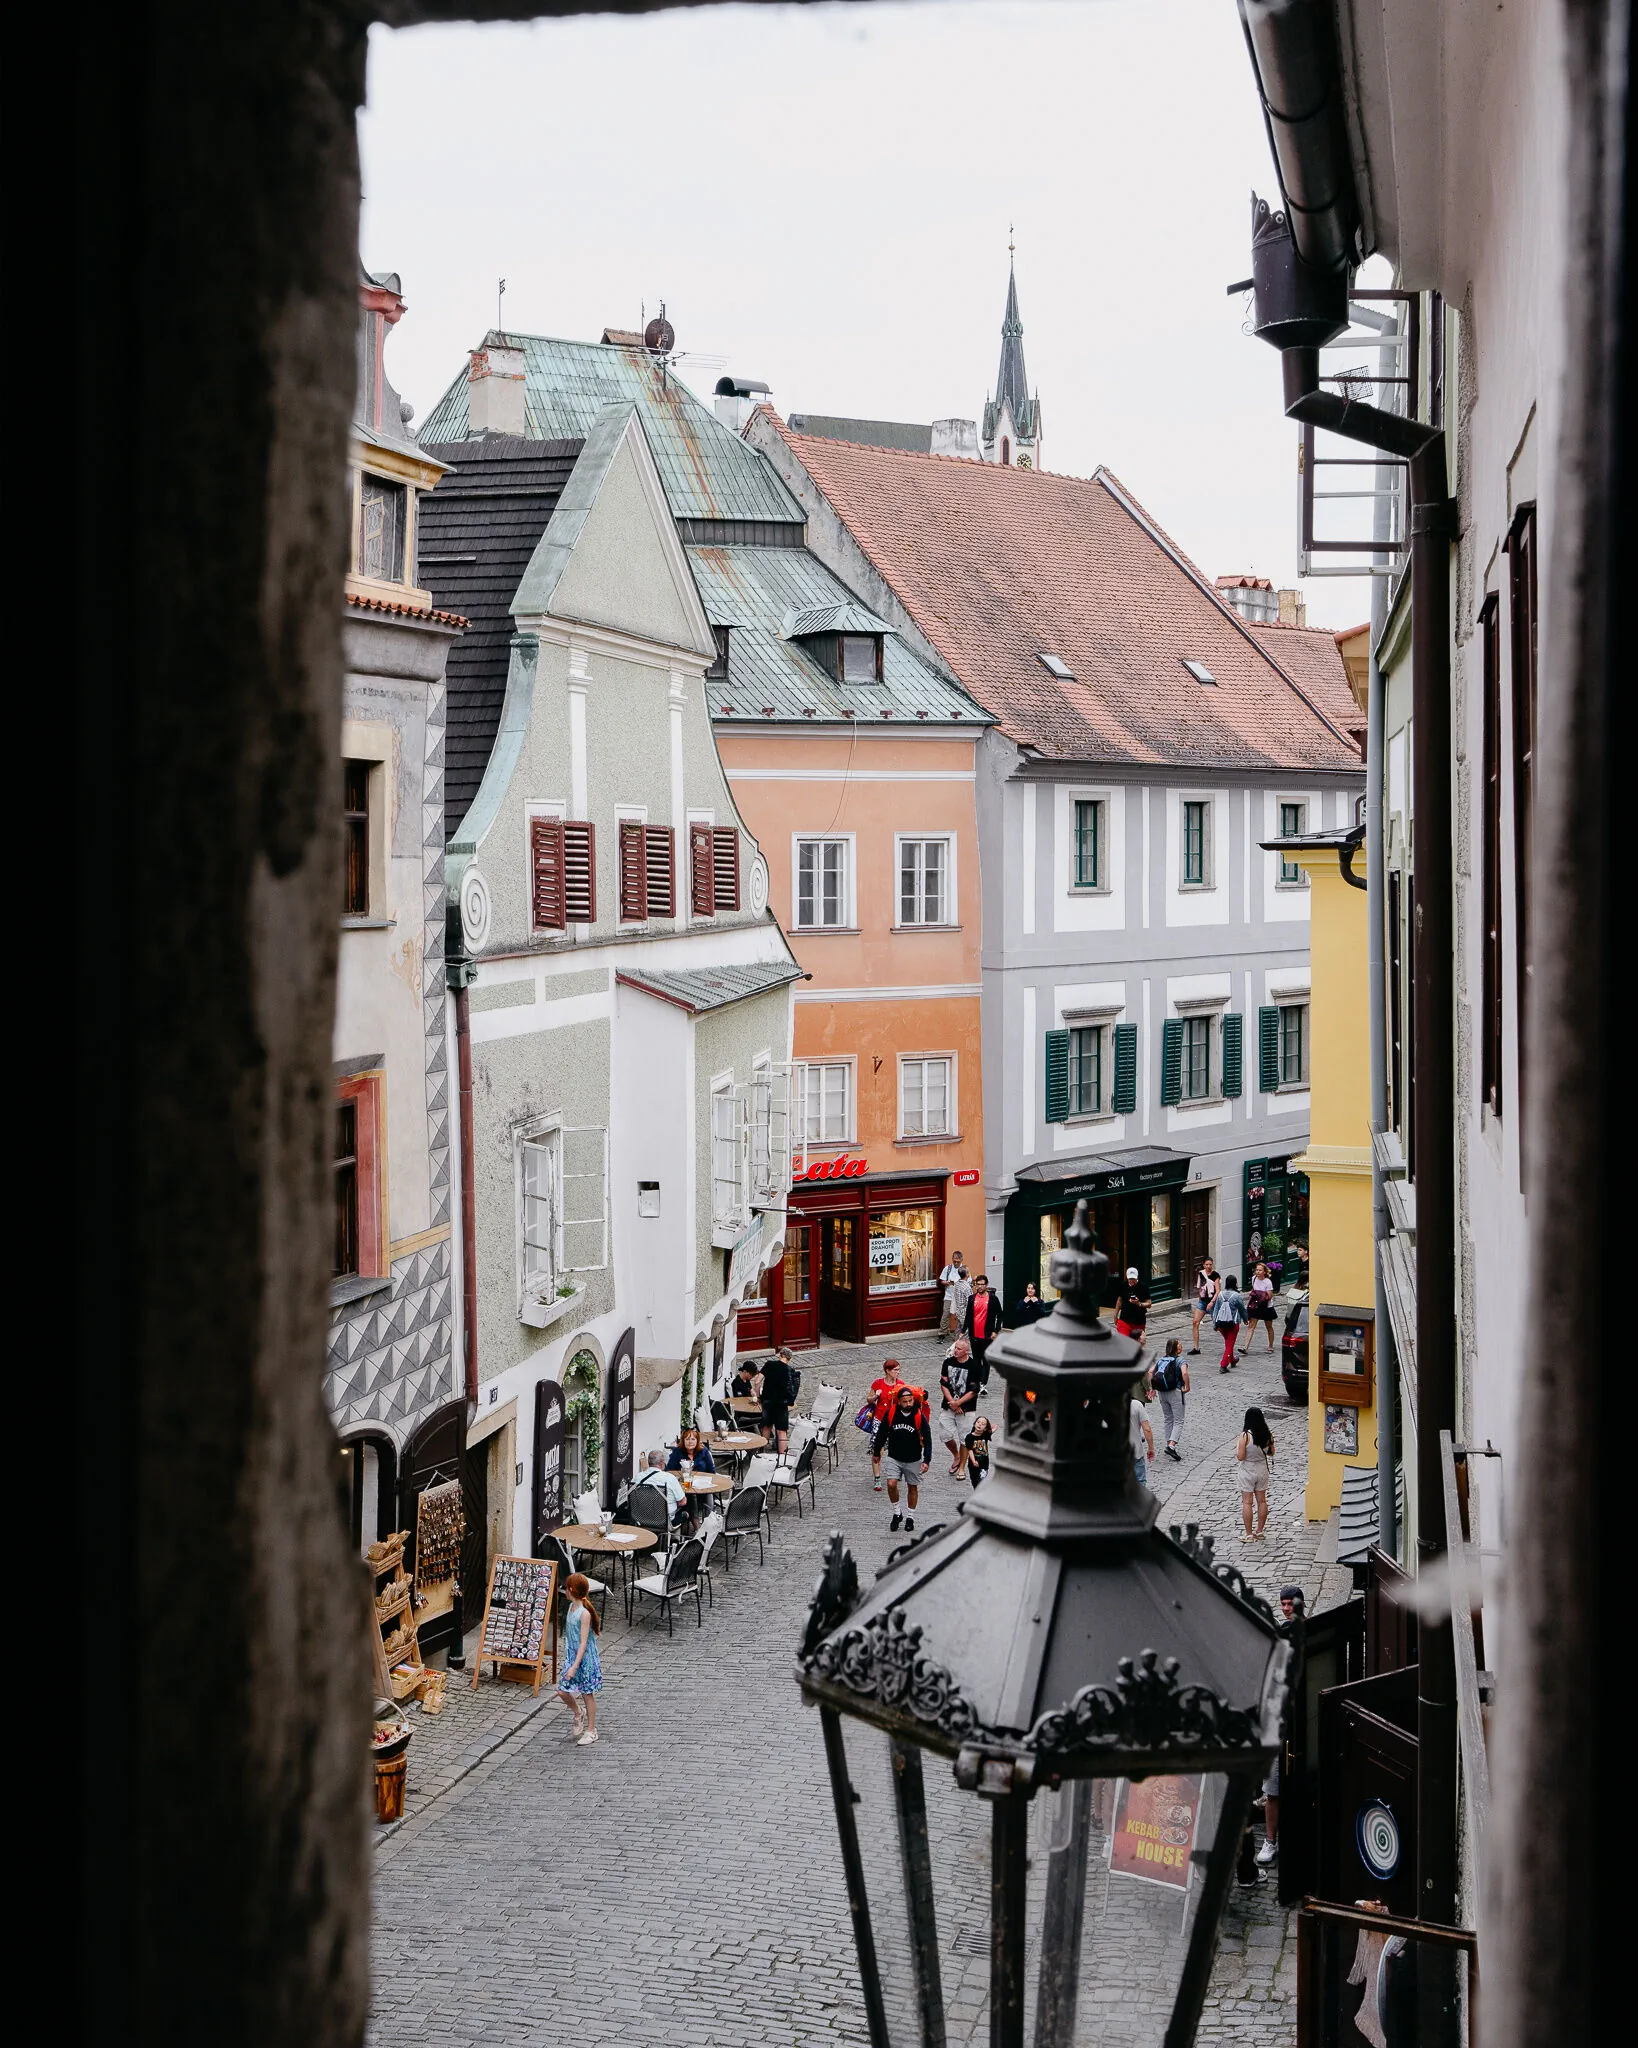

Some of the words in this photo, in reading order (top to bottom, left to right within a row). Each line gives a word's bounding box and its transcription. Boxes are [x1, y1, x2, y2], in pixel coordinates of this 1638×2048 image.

[1139, 1173, 1152, 1181] factory
[1064, 1184, 1082, 1195] jewellery
[1082, 1183, 1096, 1193] design
[871, 1253, 895, 1265] 499
[1126, 1819, 1160, 1839] KEBAB
[1136, 1840, 1185, 1868] HOUSE
